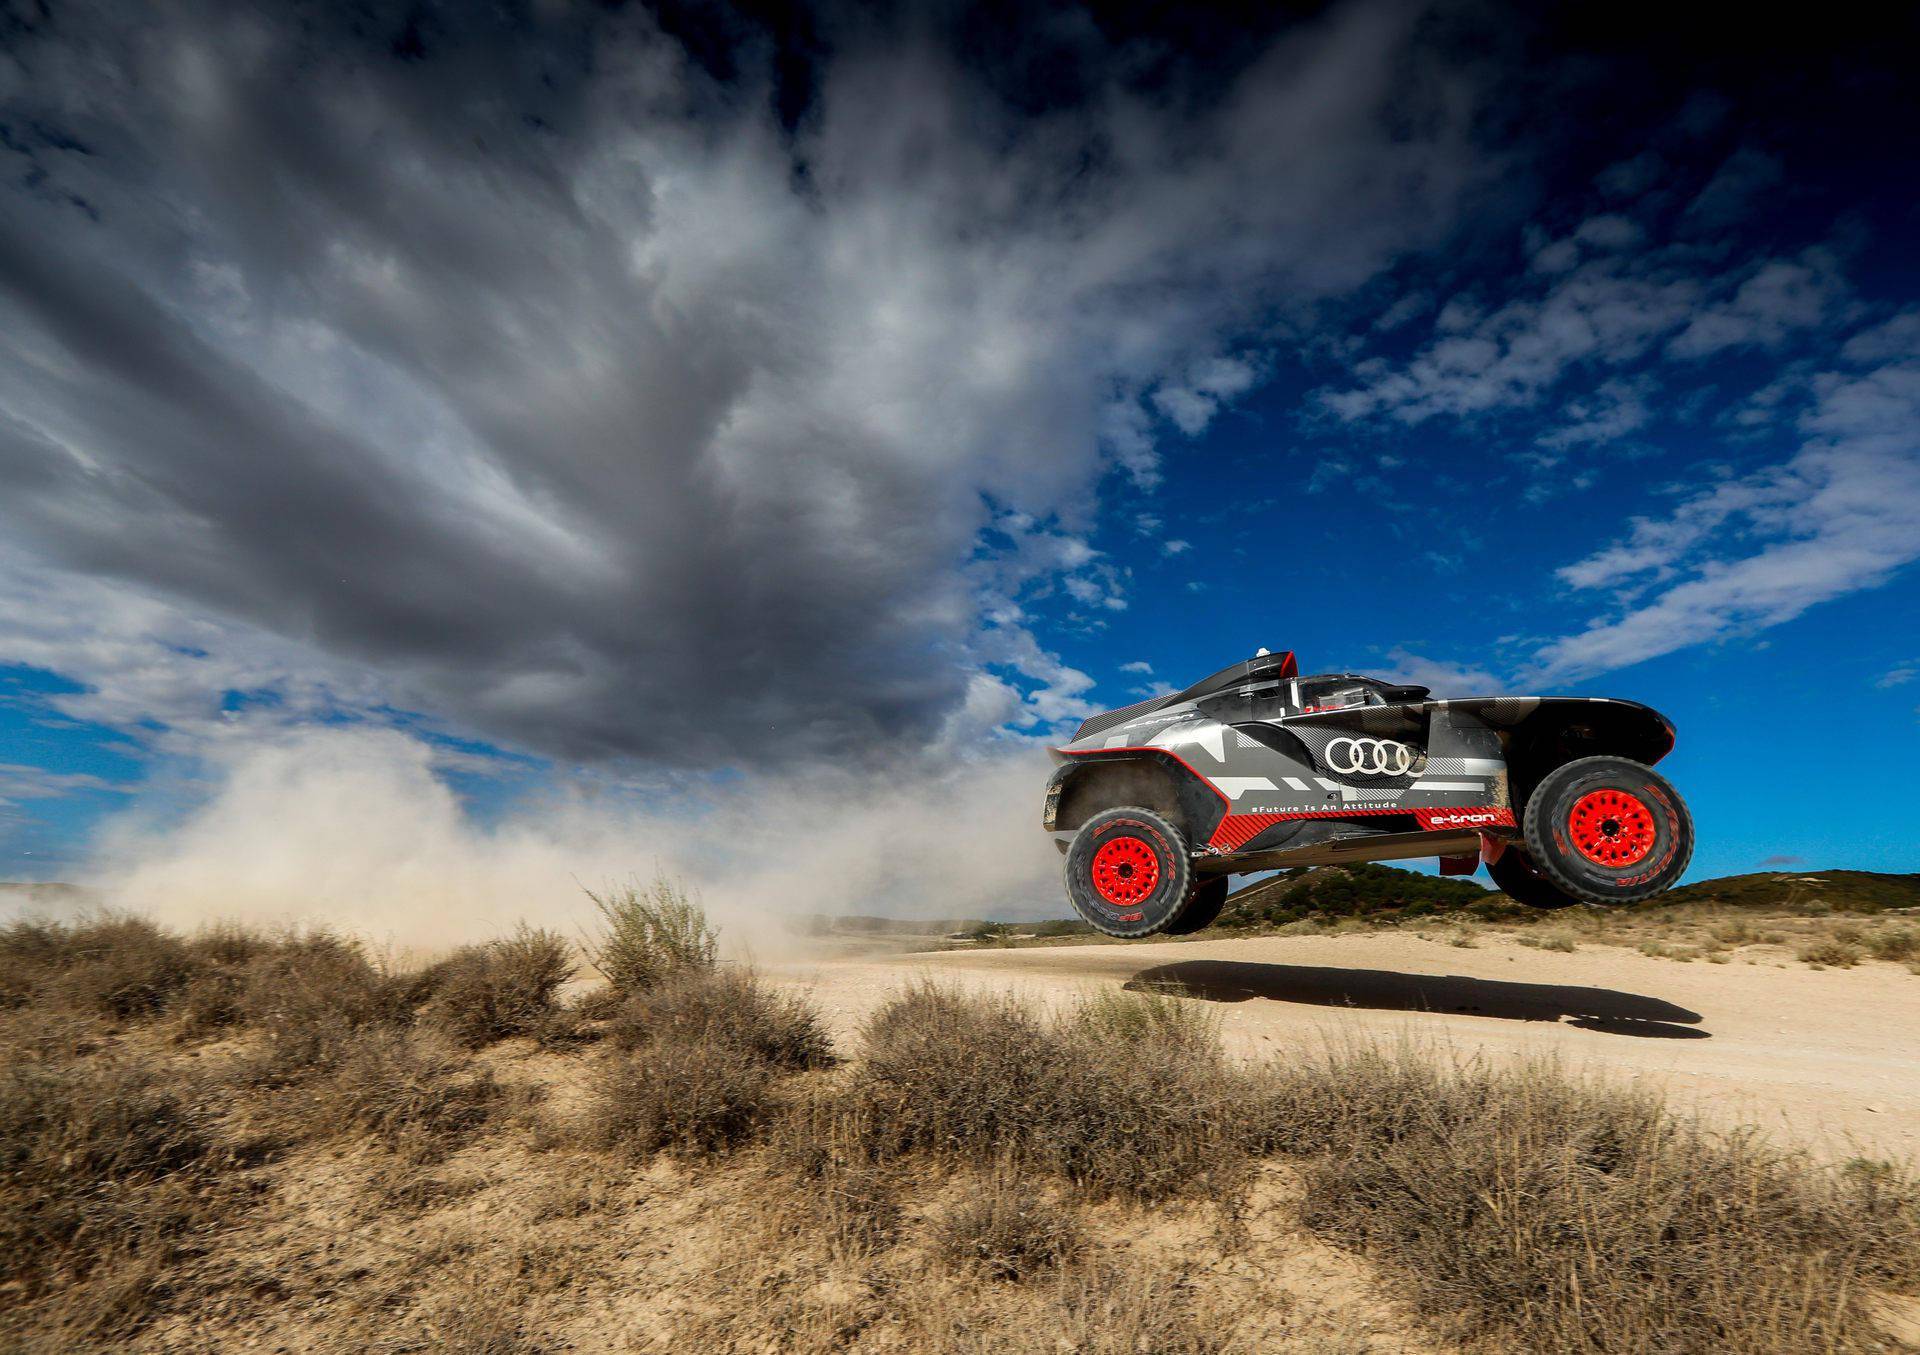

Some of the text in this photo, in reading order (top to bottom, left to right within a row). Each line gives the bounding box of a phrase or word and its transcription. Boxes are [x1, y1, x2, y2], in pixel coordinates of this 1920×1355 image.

[1251, 805, 1299, 813] #Future
[1321, 803, 1337, 811] An
[1343, 801, 1398, 810] Attitude
[1430, 813, 1495, 824] e-tron
